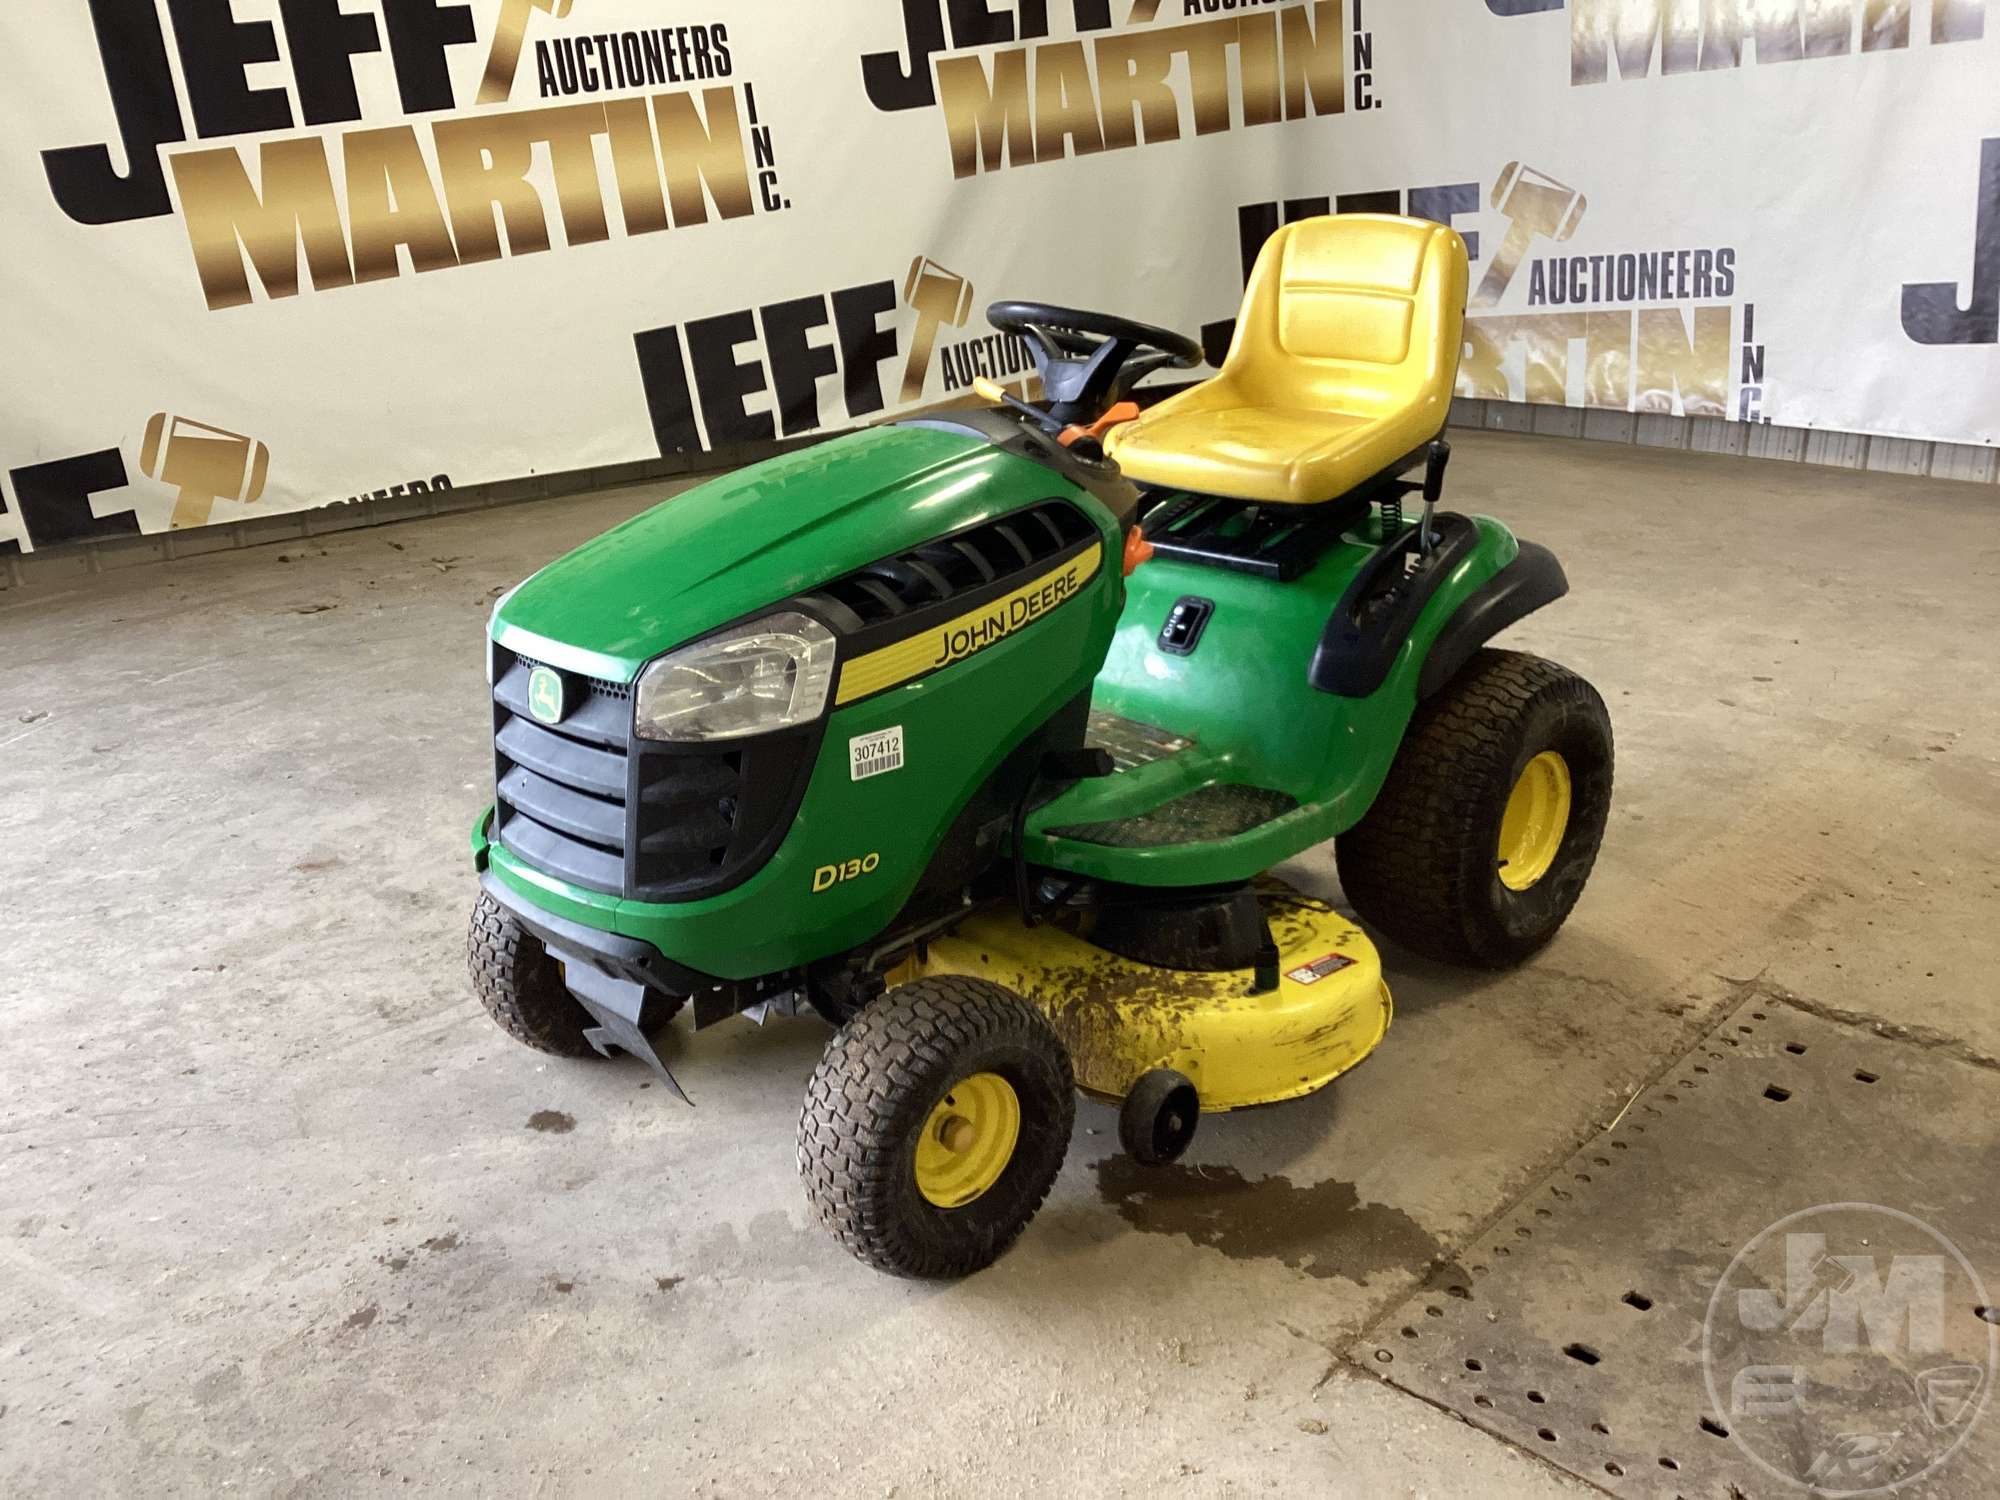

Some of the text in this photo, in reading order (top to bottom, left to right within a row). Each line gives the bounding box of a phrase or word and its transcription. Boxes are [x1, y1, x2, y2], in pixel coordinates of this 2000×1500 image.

[536, 23, 732, 98] AUCTIONEERS
[935, 4, 1346, 180] MARTIN
[169, 86, 755, 311] MARTIN
[1527, 247, 1736, 307] AUCTIONEERS
[934, 567, 1078, 665] JOHN DEERE
[854, 736, 900, 762] 307412
[812, 852, 880, 893] D130
